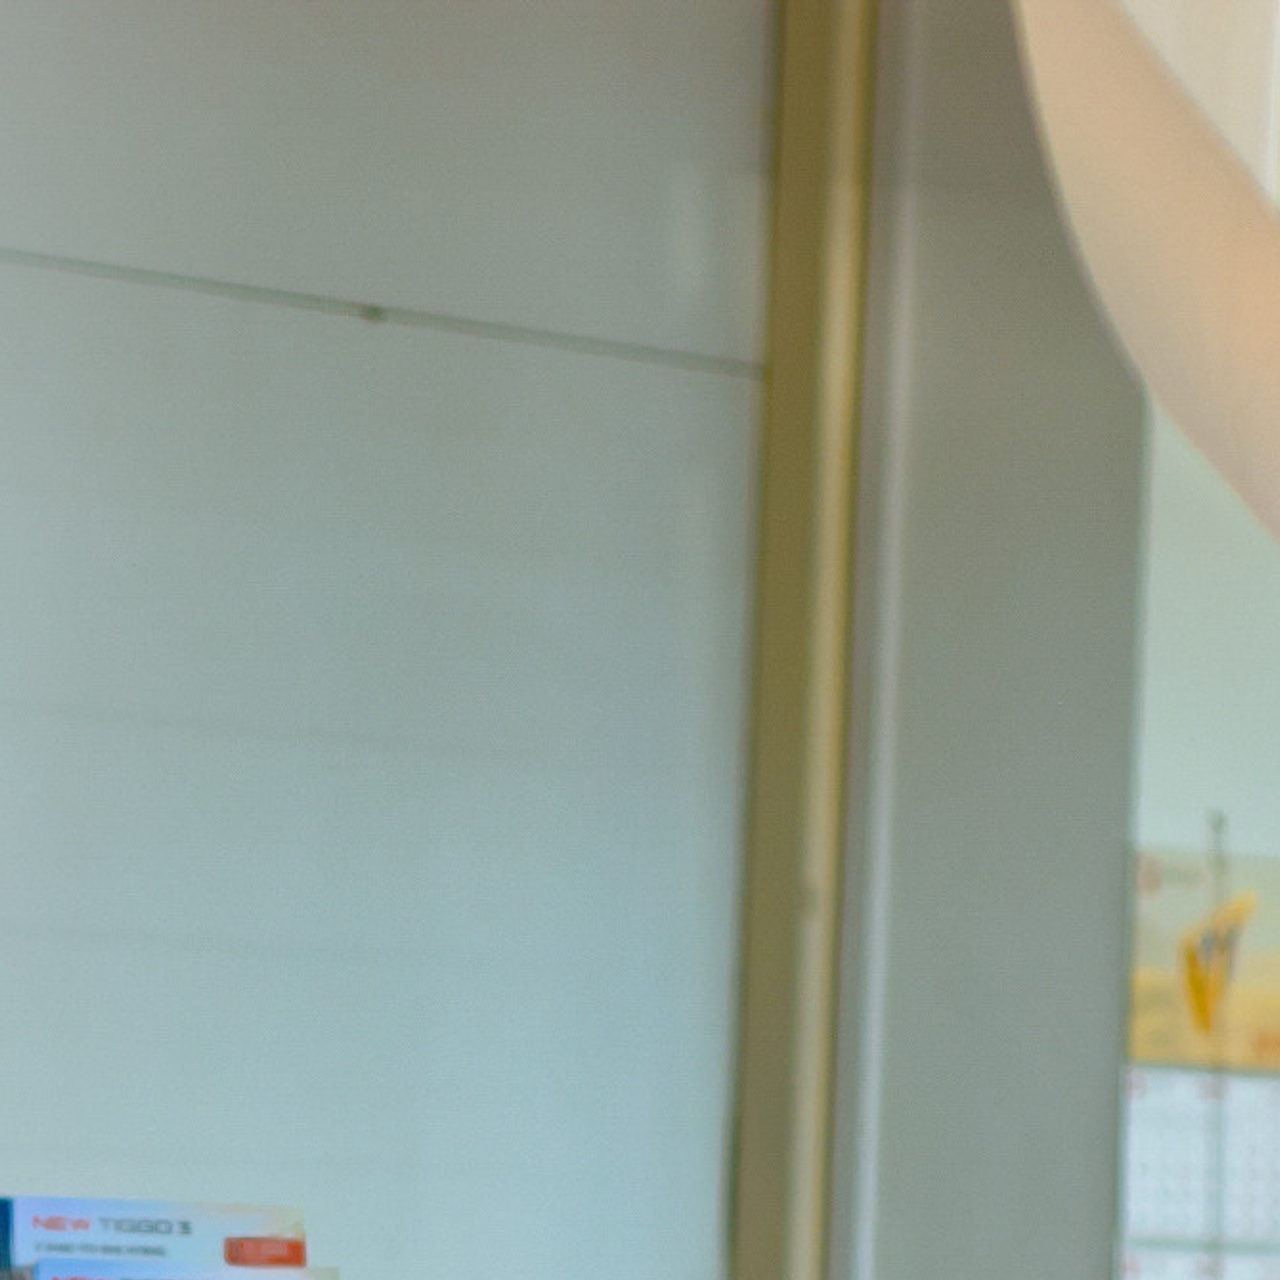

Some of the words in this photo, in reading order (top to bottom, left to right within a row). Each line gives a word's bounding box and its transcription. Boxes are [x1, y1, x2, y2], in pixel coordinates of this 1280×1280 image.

[32, 1216, 91, 1231] NEW
[97, 1217, 173, 1234] TIGGO
[178, 1221, 192, 1235] 3
